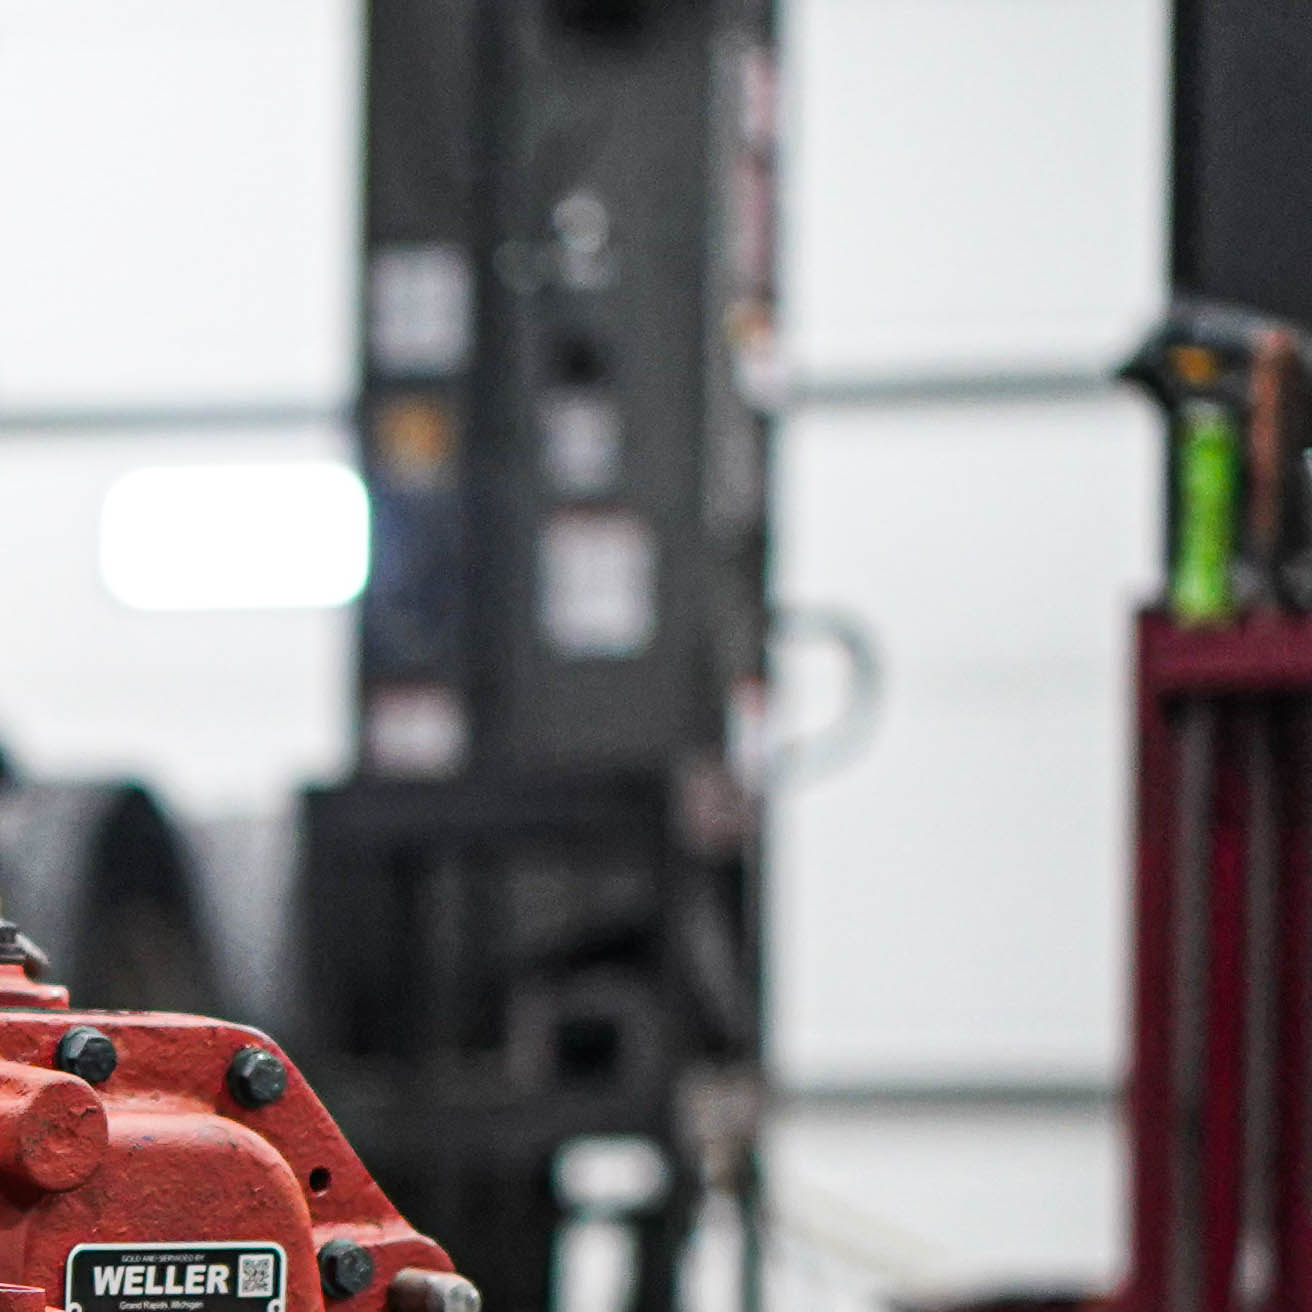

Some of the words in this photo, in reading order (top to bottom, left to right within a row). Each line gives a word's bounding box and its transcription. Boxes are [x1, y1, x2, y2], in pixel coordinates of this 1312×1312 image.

[93, 1264, 230, 1297] WELLER
[119, 1301, 143, 1311] Grand
[171, 1300, 205, 1311] Michigan
